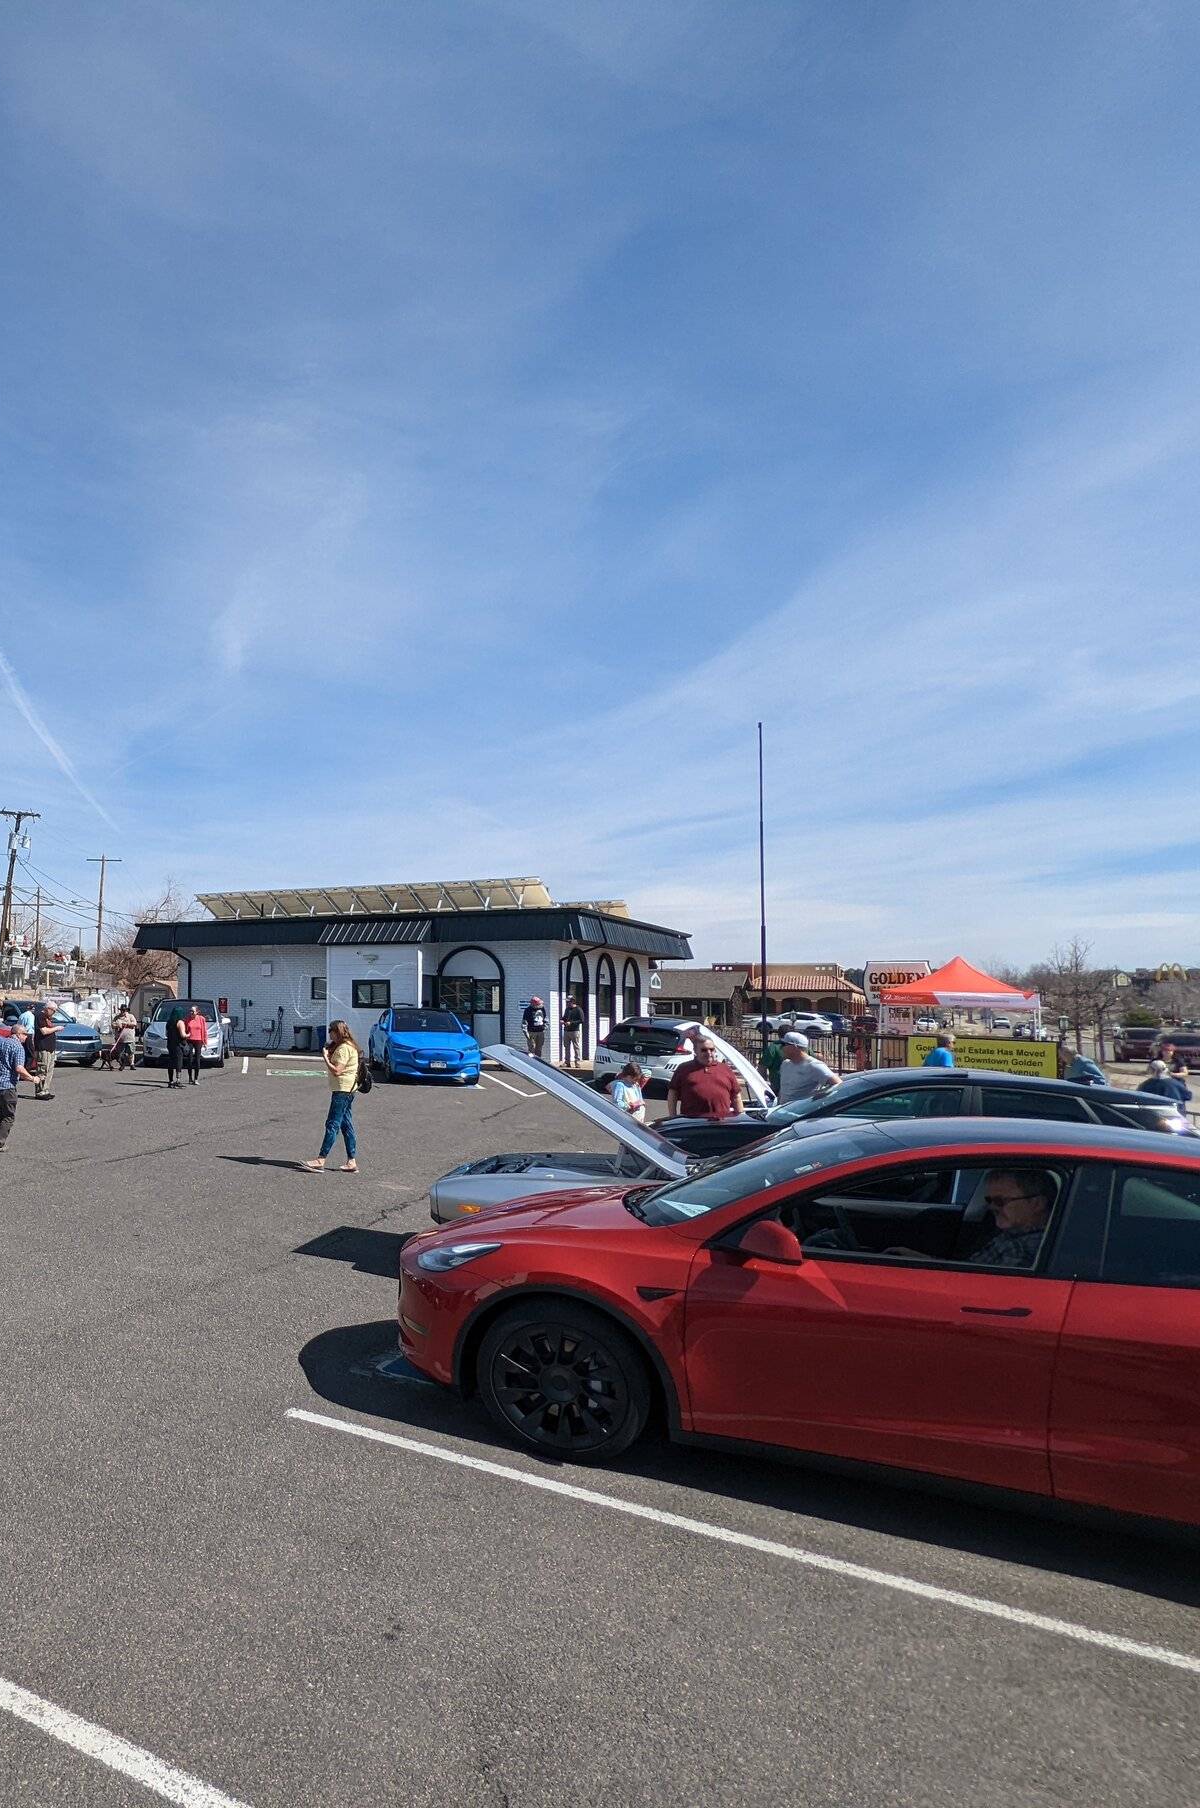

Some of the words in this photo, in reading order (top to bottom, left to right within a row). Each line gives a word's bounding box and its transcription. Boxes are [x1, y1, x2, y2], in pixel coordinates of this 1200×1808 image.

[968, 1046, 995, 1055] Estate
[997, 1048, 1013, 1056] Has
[1016, 1049, 1046, 1058] Moved
[964, 1056, 1009, 1066] Downtown
[1011, 1058, 1043, 1067] Golden
[1007, 1068, 1040, 1077] Avenue
